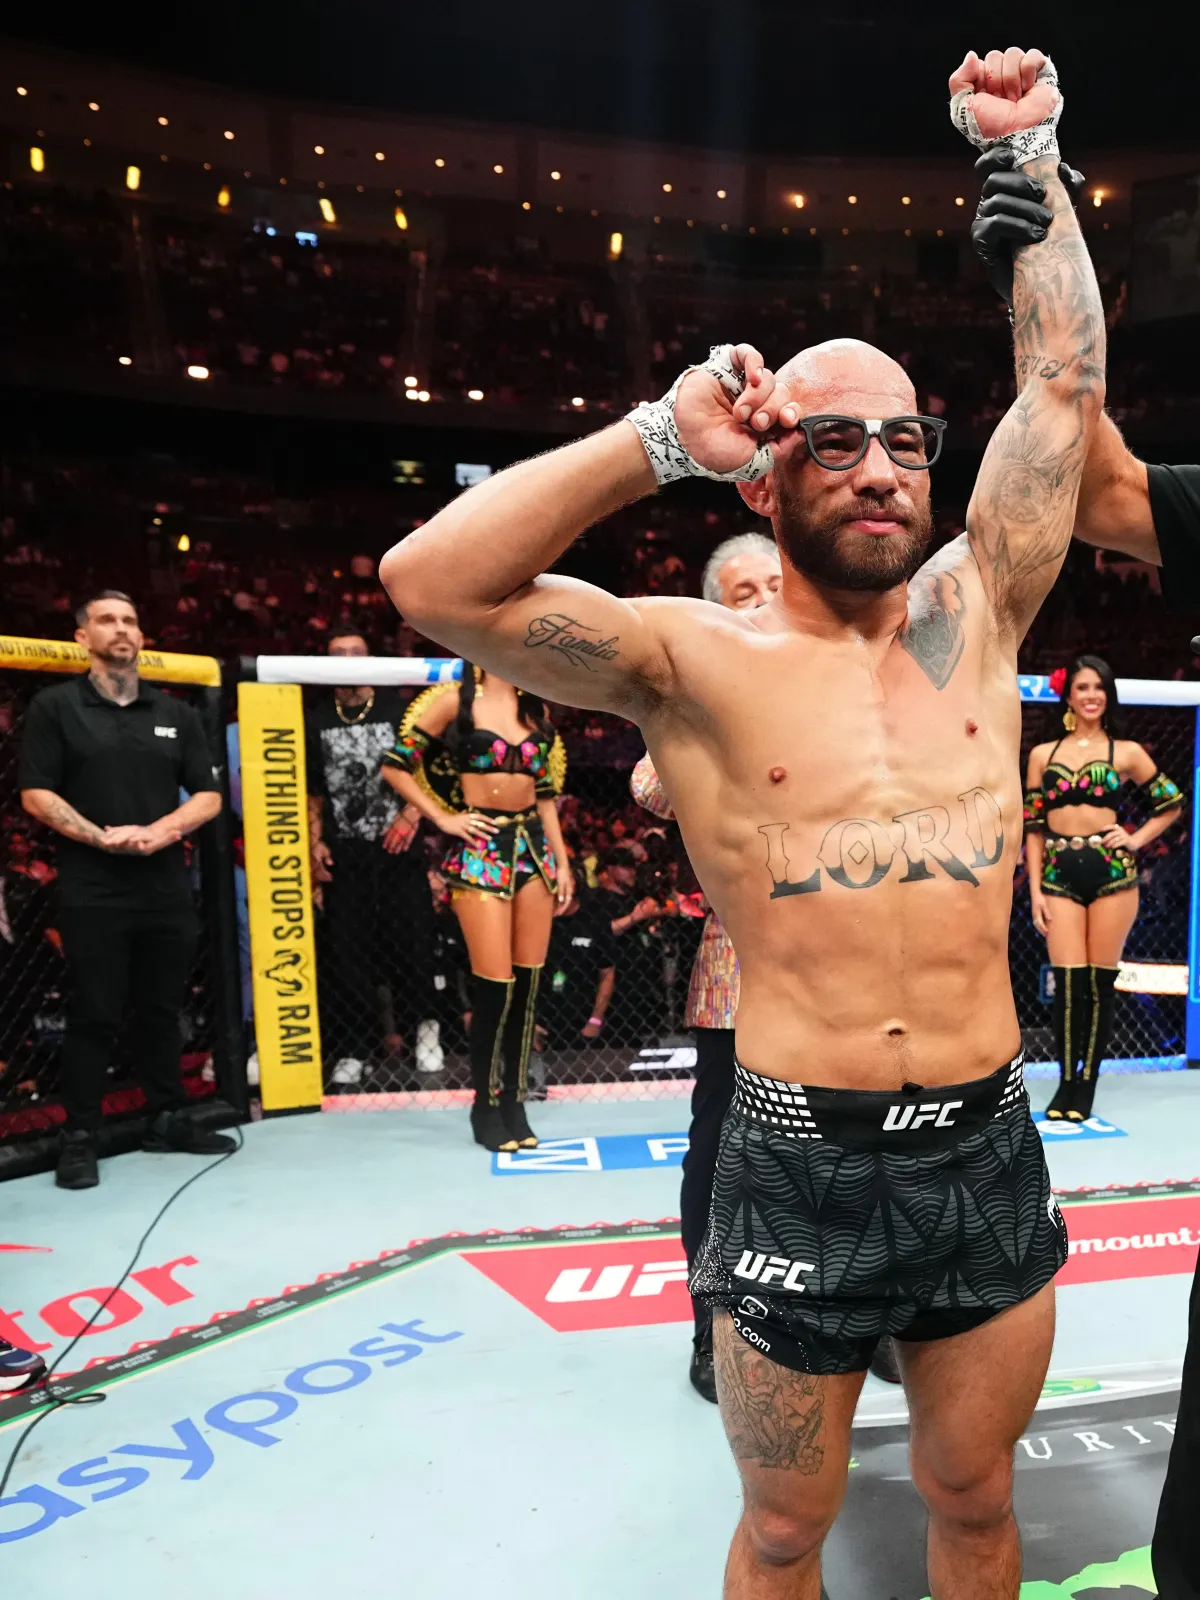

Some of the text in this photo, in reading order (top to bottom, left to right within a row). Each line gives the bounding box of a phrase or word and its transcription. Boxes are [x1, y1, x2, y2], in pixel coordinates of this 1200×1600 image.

[523, 613, 620, 673] Familia
[154, 725, 178, 739] UFC
[758, 785, 1004, 900] LORD
[262, 727, 313, 1065] NOTHING STOPS RAM
[882, 1100, 963, 1131] UFC
[545, 1260, 689, 1303] UF
[733, 1249, 816, 1293] UFC
